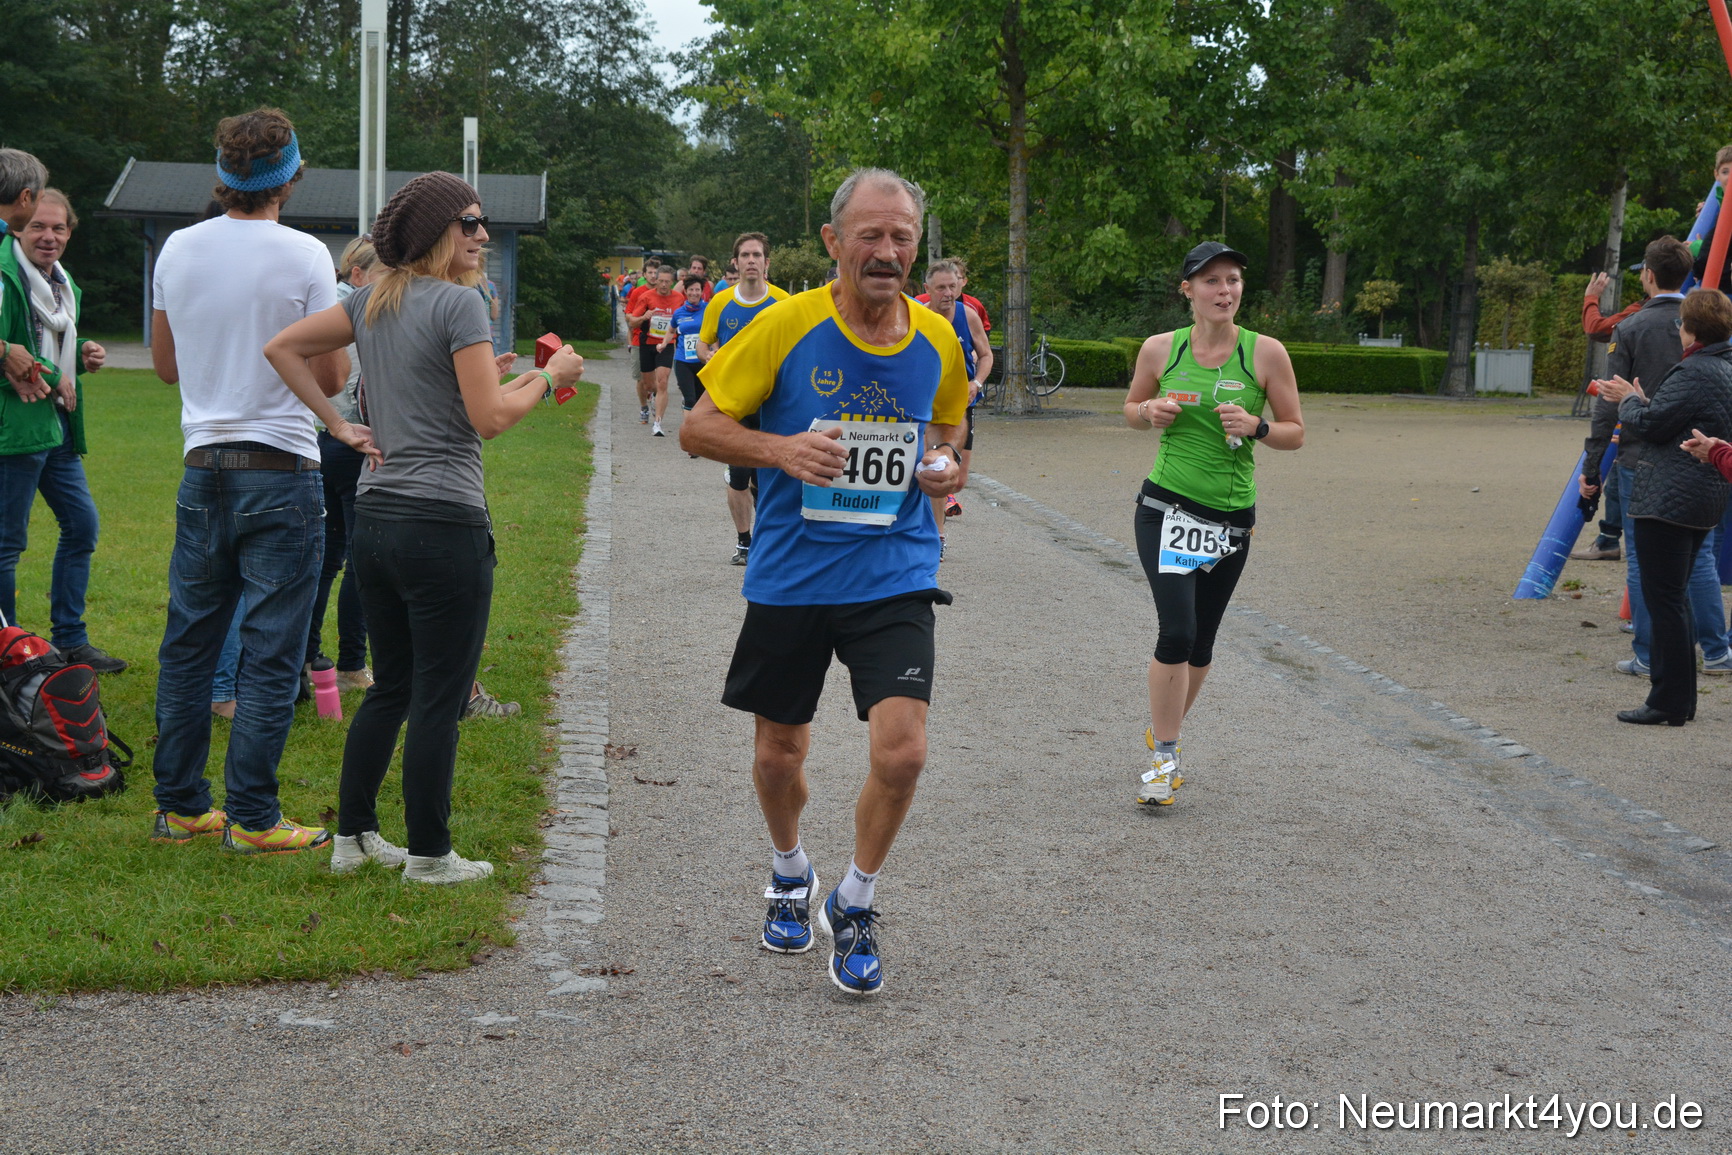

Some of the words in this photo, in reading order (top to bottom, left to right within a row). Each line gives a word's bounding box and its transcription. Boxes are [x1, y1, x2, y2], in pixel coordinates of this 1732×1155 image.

[657, 321, 668, 330] 57
[817, 378, 836, 386] Jahre
[1167, 392, 1198, 403] OBI
[848, 431, 899, 442] Neumarkt
[204, 452, 249, 468] PMA
[825, 447, 906, 486] 466
[832, 492, 880, 509] Rudolf
[1175, 555, 1206, 568] Katha
